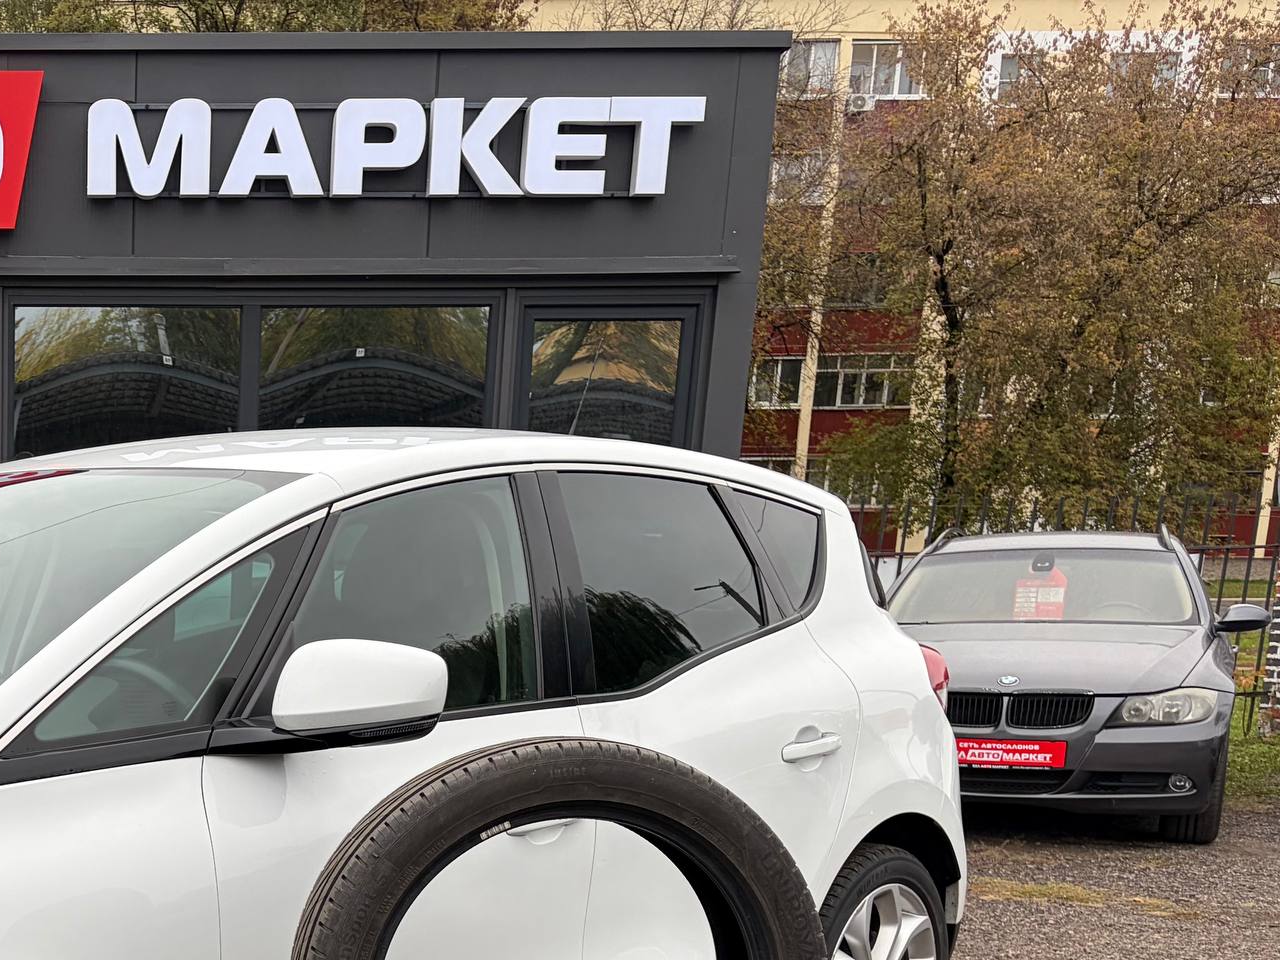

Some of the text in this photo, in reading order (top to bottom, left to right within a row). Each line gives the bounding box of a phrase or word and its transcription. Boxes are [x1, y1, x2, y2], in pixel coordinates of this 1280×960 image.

[86, 96, 707, 199] МАРКЕТ
[981, 742, 1040, 750] АВТОСАЛОНОВ
[968, 751, 1001, 760] АВТО
[1002, 752, 1052, 762] МАРКЕТ
